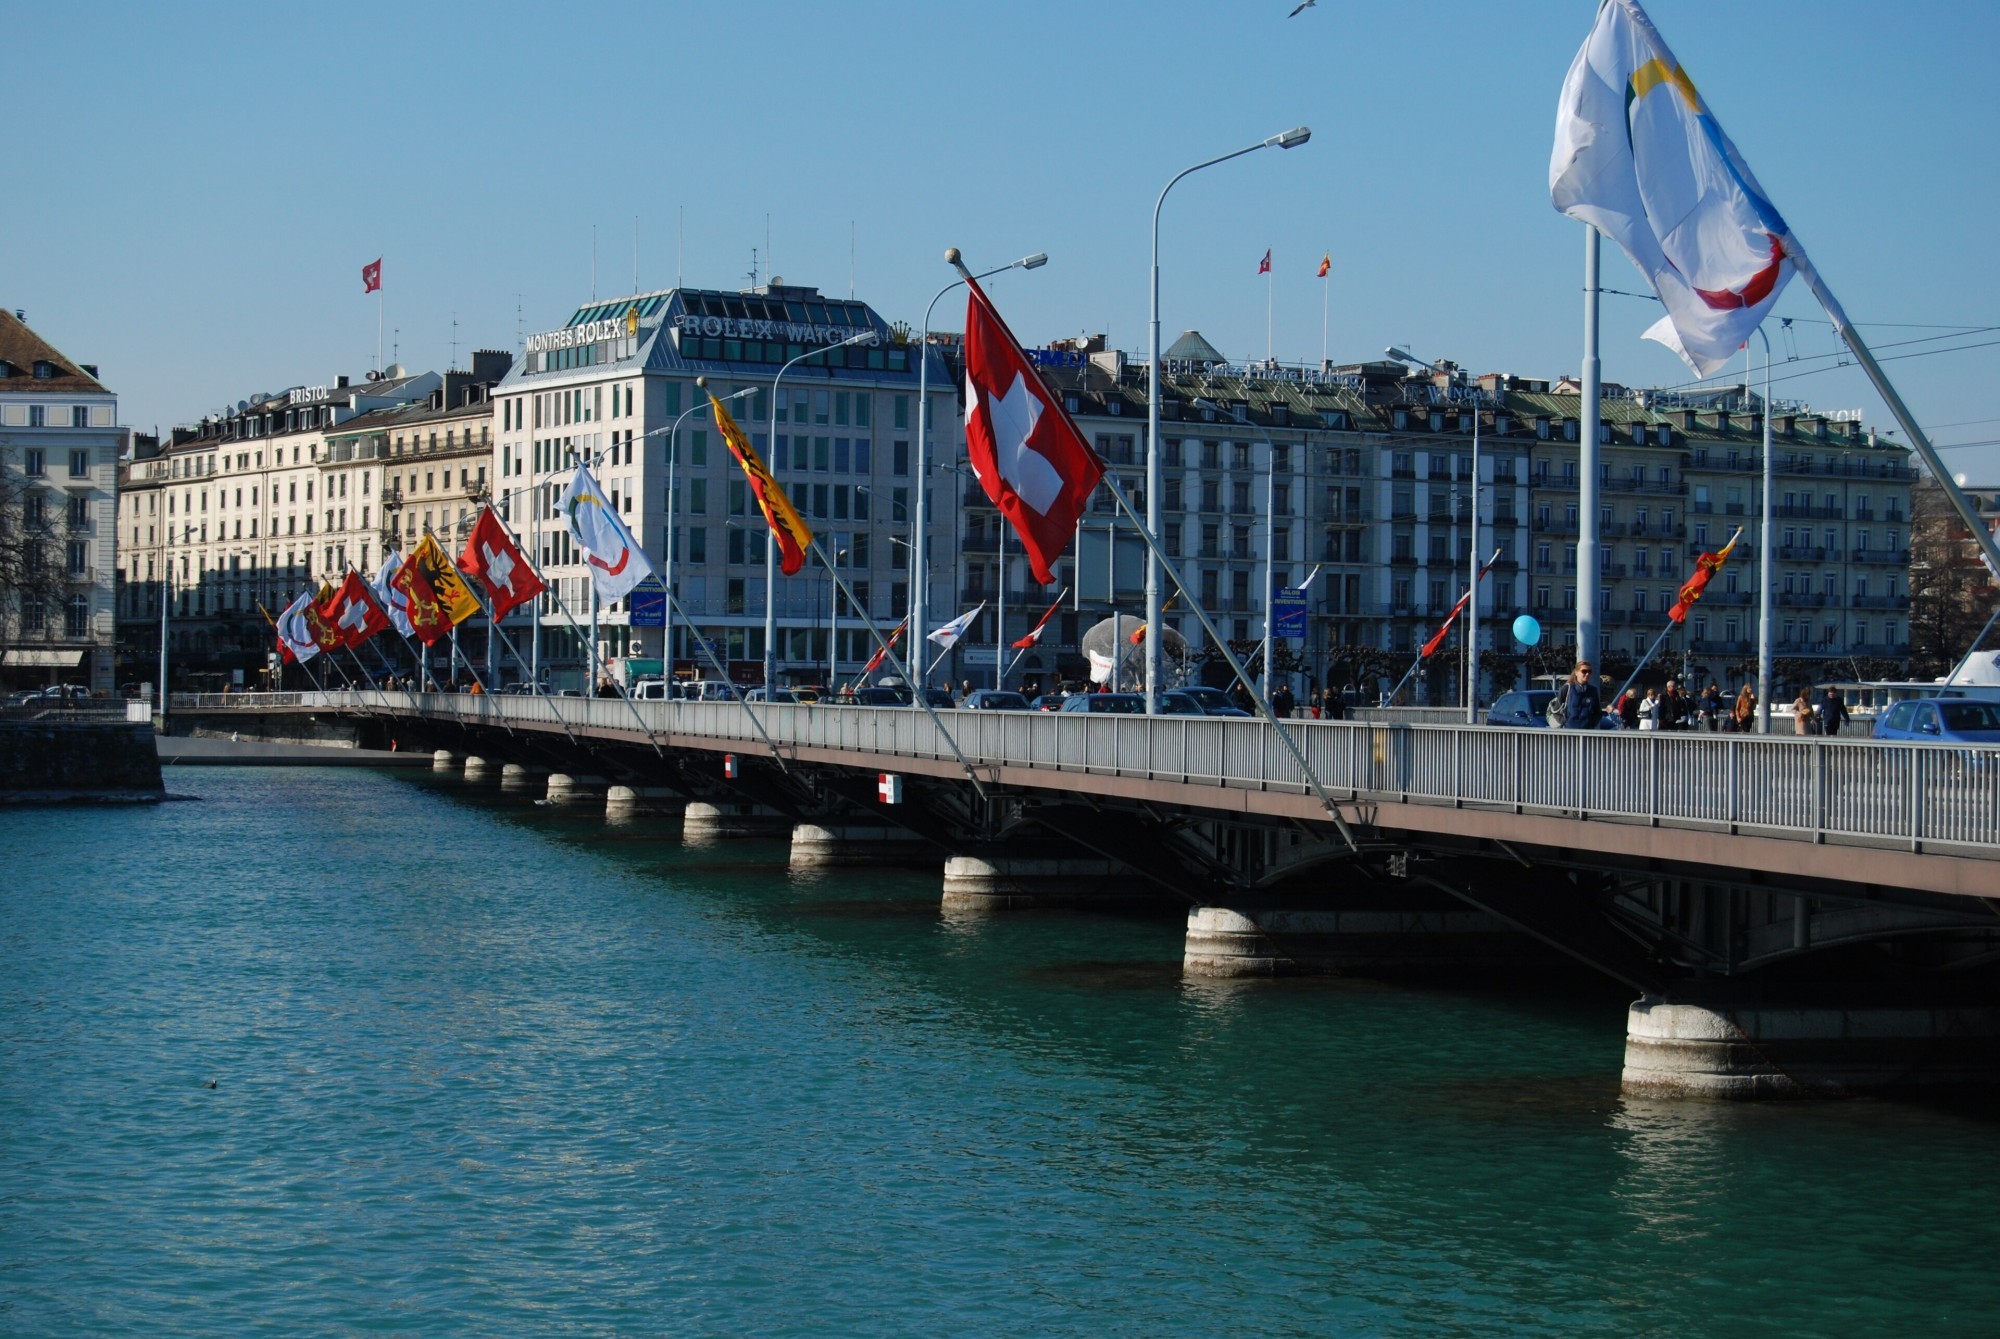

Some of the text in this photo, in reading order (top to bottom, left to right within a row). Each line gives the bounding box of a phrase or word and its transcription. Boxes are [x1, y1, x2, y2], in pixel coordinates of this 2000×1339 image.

[526, 317, 622, 352] MONTRES ROLEX
[684, 315, 773, 340] ROLEX
[1203, 361, 1242, 378] Swiss
[1248, 363, 1299, 381] Private
[1302, 367, 1359, 389] Banking
[290, 385, 330, 405] BRISTOL
